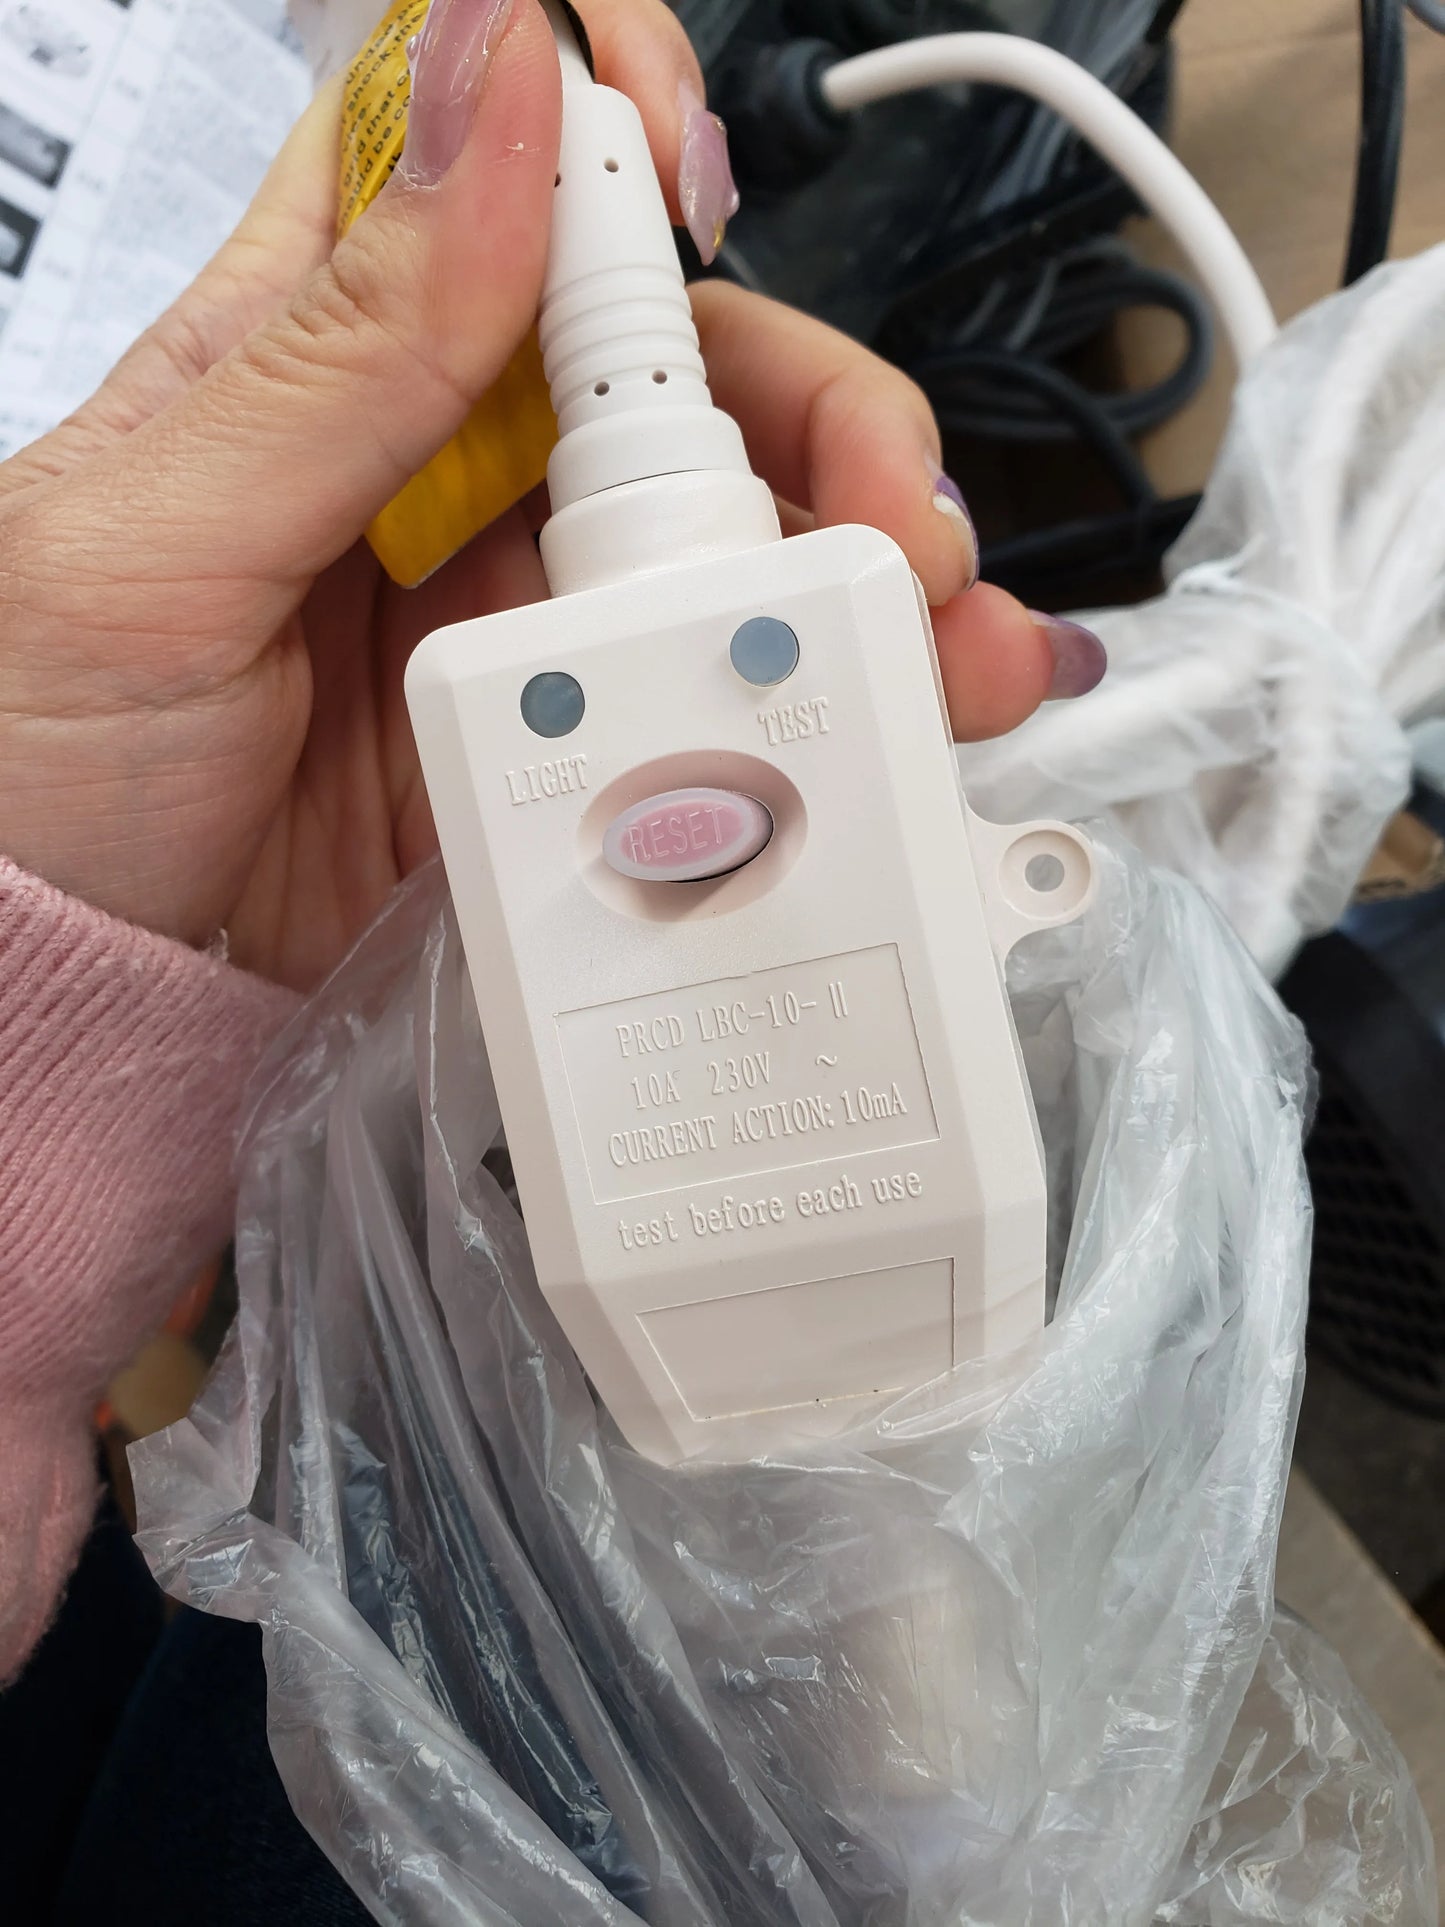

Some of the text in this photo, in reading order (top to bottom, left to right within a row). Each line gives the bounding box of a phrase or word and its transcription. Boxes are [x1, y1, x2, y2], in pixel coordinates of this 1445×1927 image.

[757, 696, 830, 746] TEST
[505, 754, 589, 806] LIGHT
[627, 806, 726, 863] RESET
[616, 1014, 685, 1058] PRCD
[630, 1069, 681, 1110] 10A
[708, 1050, 771, 1095] 230V
[608, 1081, 907, 1167] CURRENT ACTION: 10mA
[618, 1171, 923, 1250] test before each use
